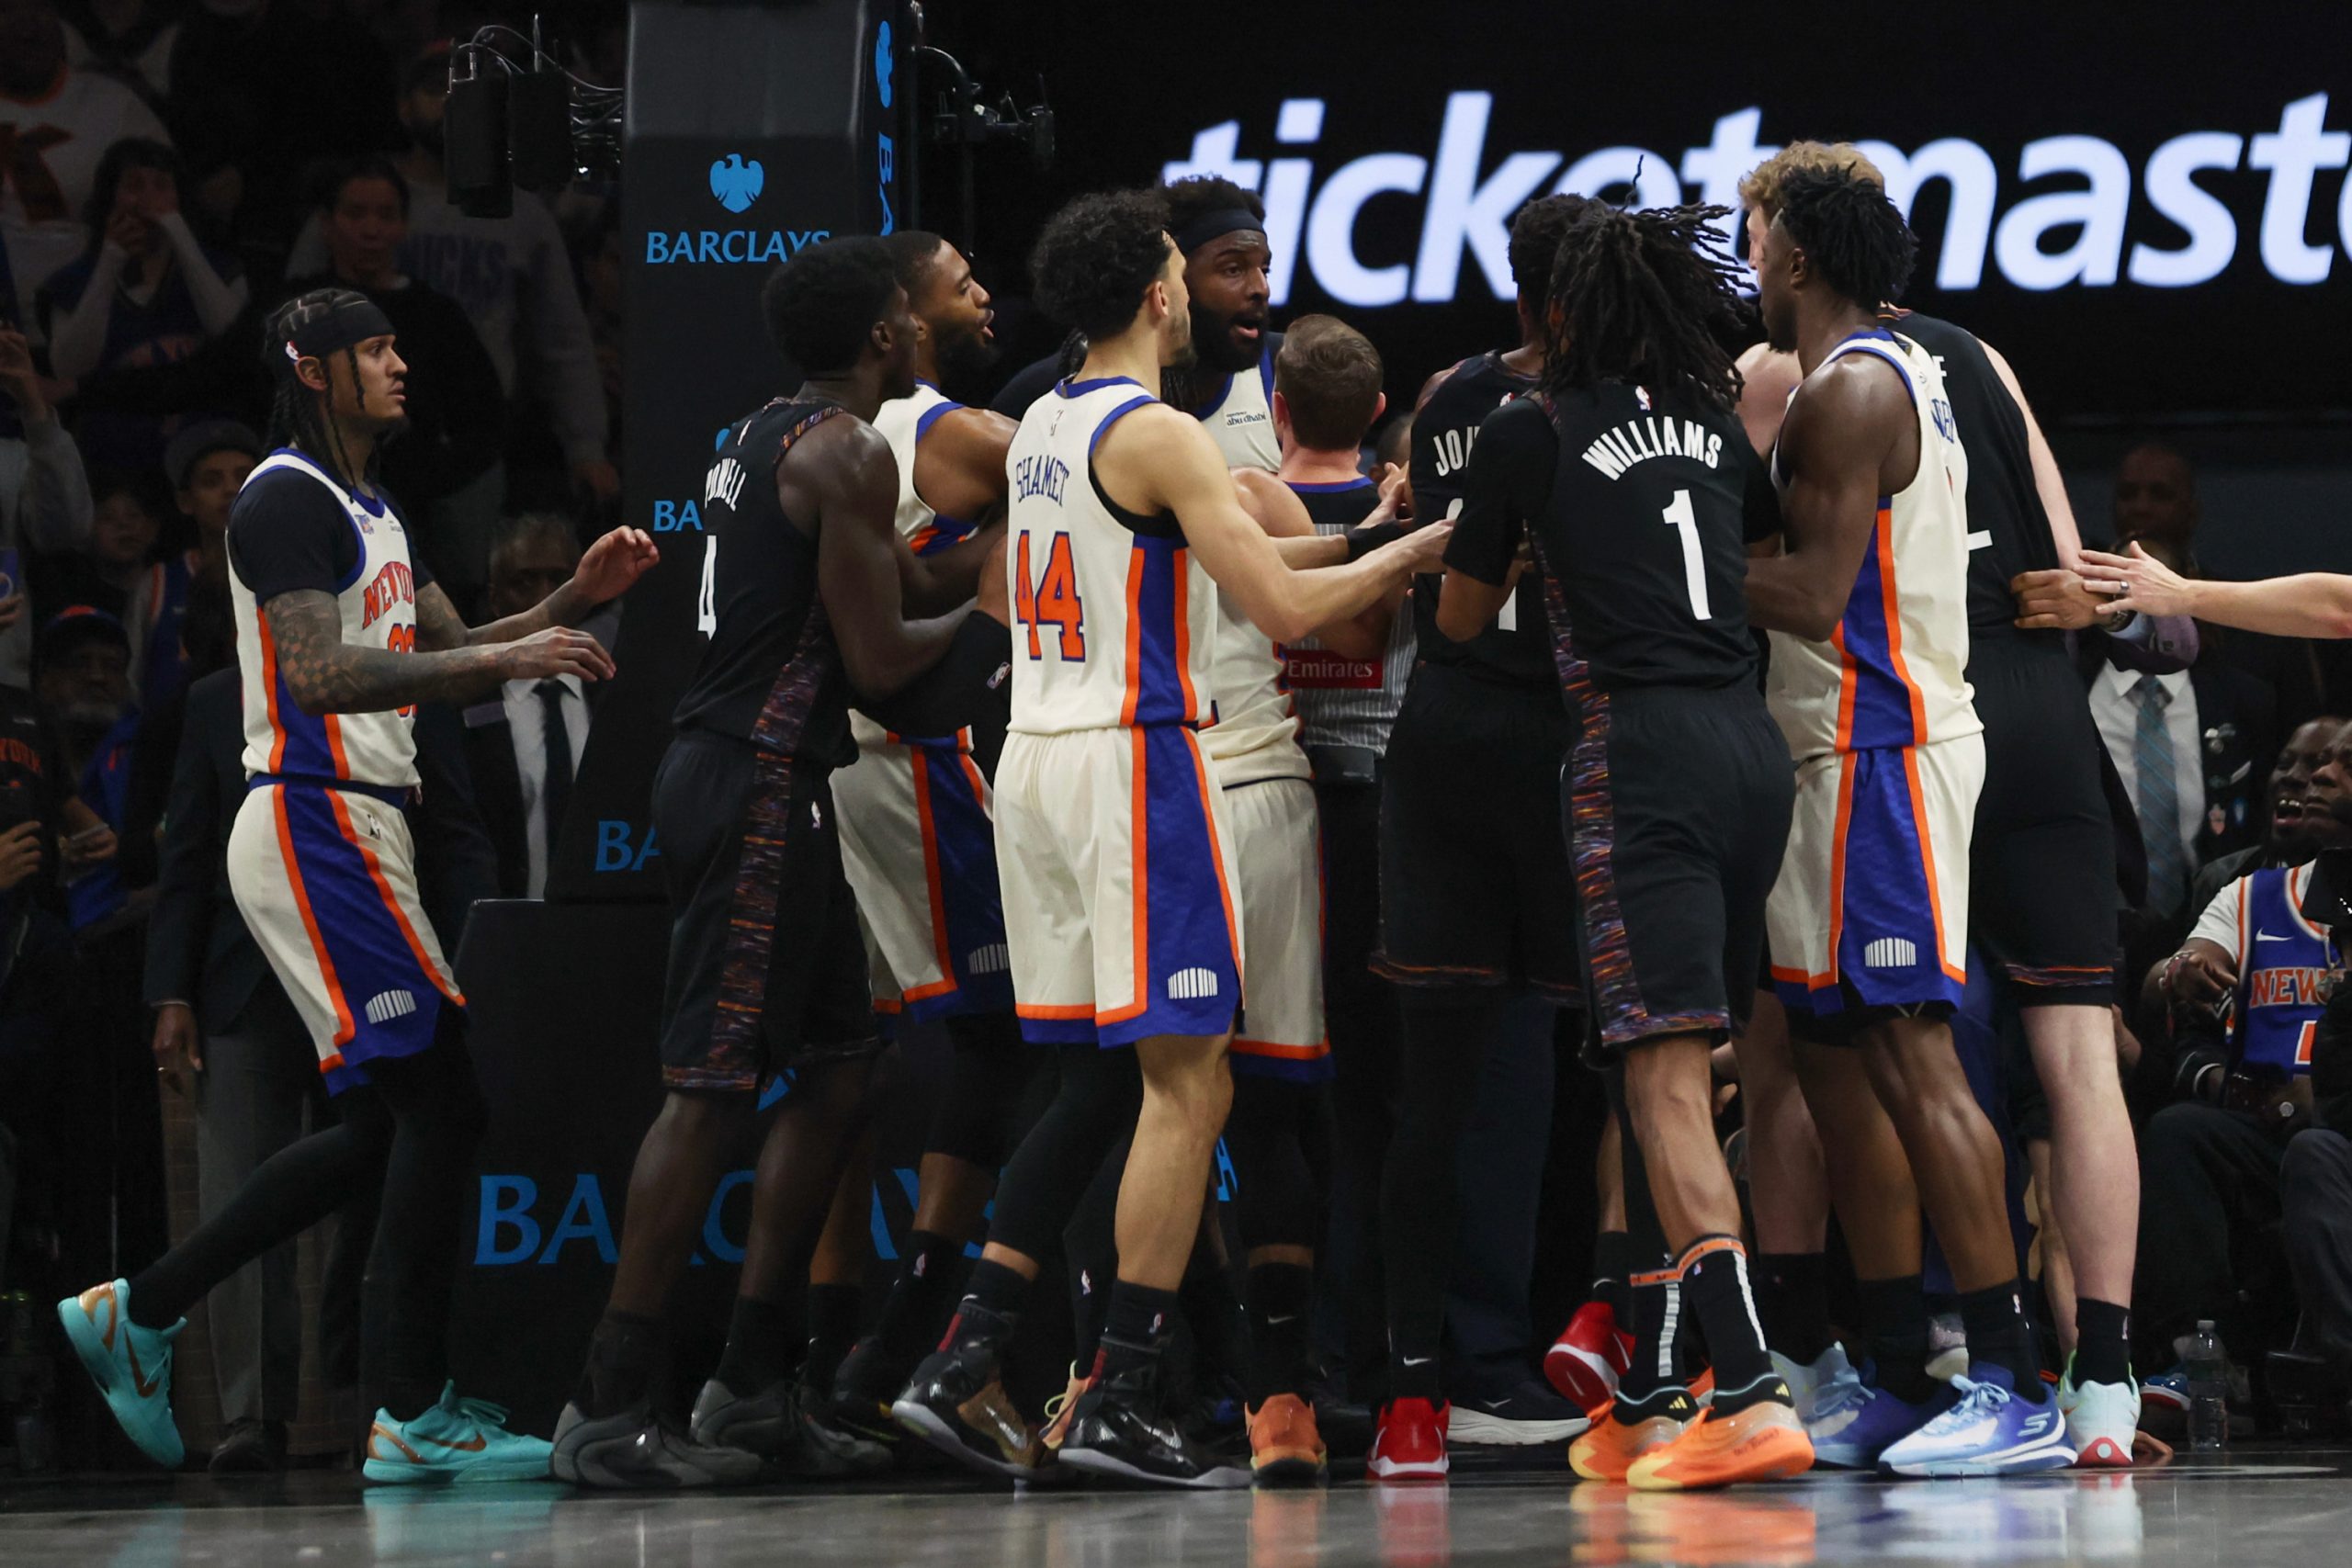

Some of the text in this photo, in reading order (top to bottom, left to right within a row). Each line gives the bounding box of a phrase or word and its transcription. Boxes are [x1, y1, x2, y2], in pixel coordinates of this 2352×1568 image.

[1161, 89, 2352, 308] icktmast
[1016, 455, 1069, 507] SHAMET
[1581, 415, 1723, 481] WILLIAMS
[1015, 530, 1085, 661] 44
[1662, 489, 1713, 622] 1
[1287, 660, 1374, 678] Emirates
